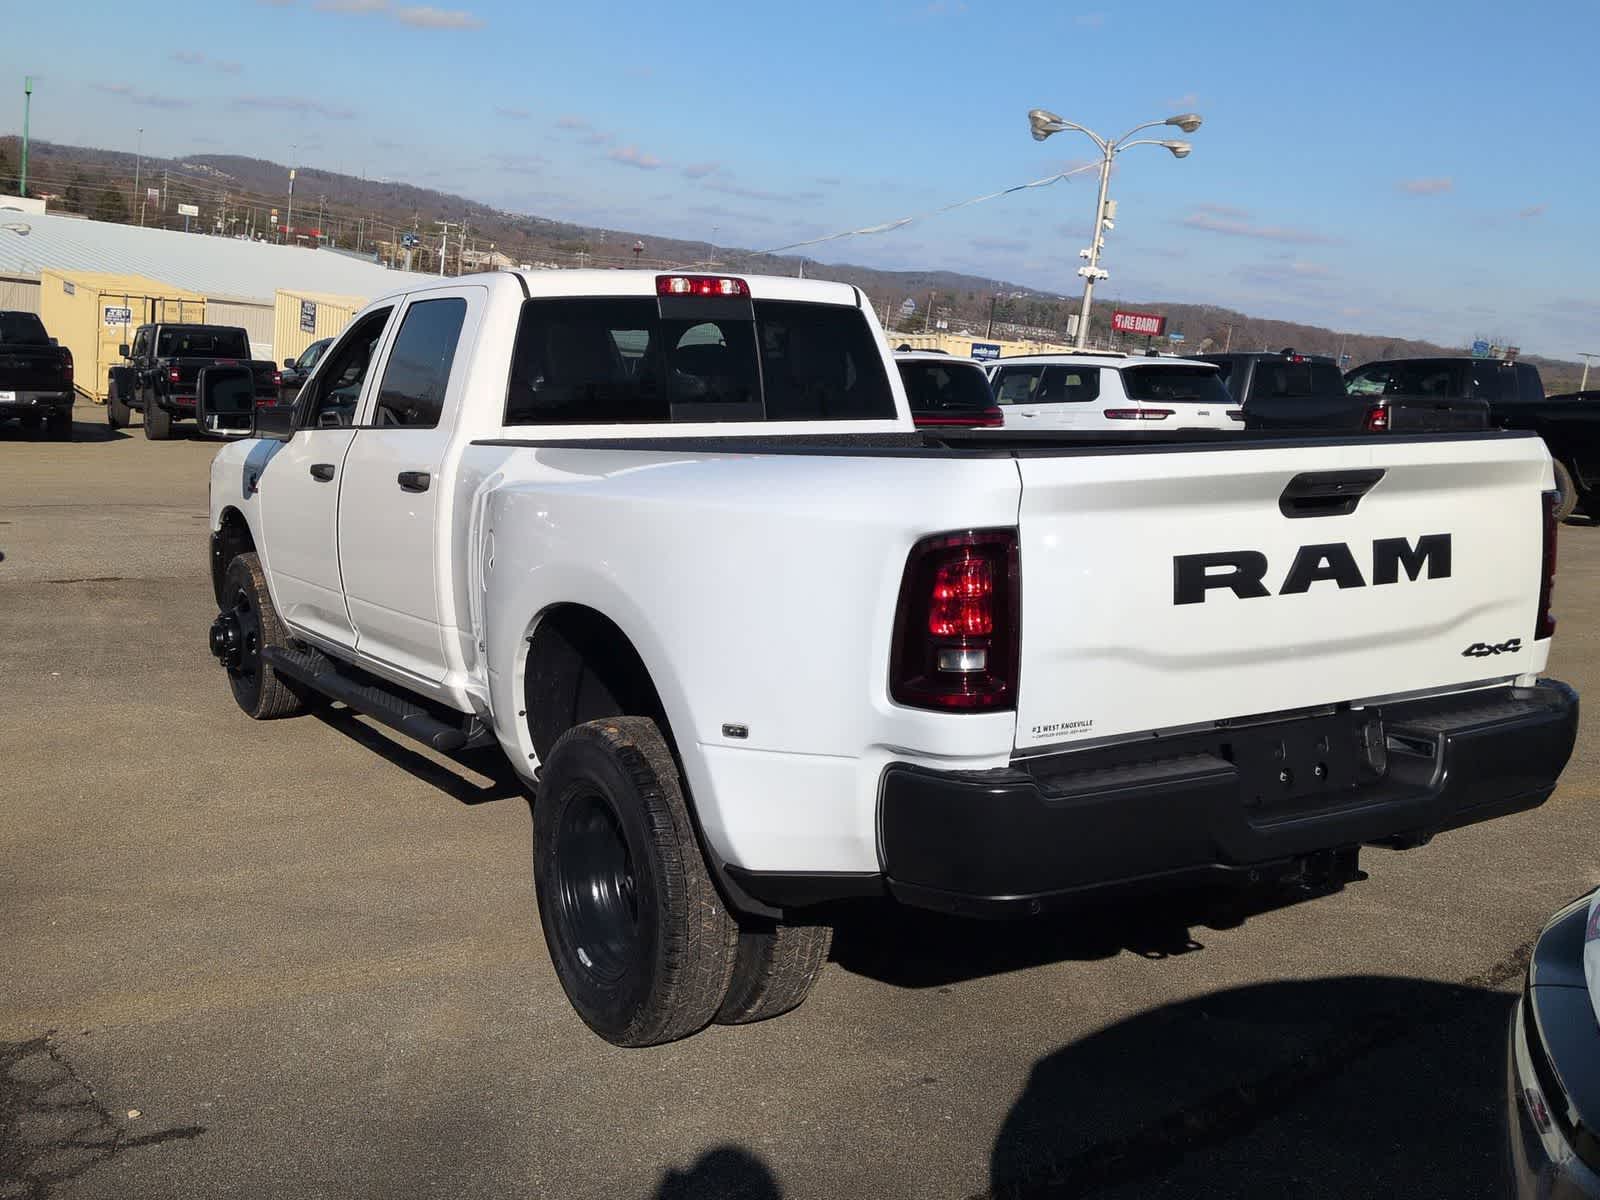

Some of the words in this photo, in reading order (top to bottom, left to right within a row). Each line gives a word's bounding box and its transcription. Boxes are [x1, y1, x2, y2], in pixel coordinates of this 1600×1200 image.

[1115, 314, 1136, 329] TIRE
[1135, 316, 1160, 333] BARN
[1173, 533, 1452, 606] RAM
[1043, 724, 1059, 732] WEST
[1061, 720, 1092, 729] KNOXVILLE
